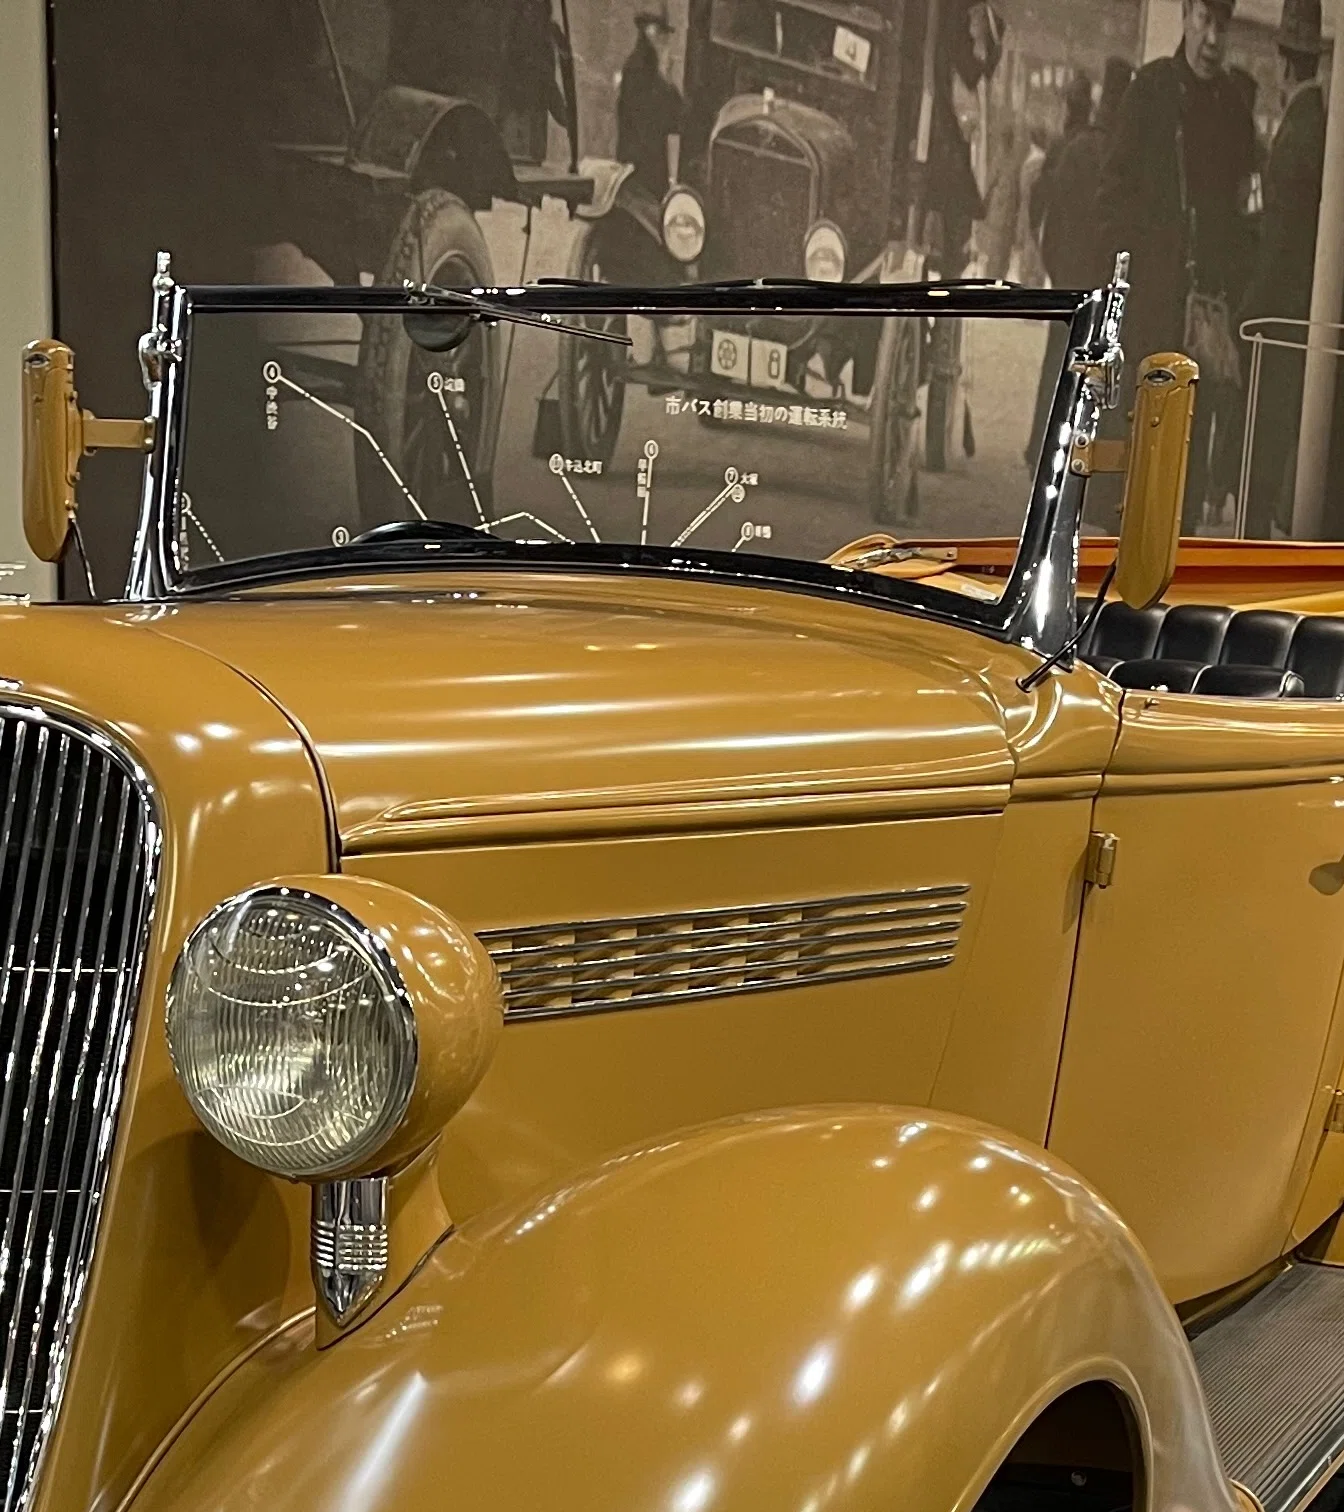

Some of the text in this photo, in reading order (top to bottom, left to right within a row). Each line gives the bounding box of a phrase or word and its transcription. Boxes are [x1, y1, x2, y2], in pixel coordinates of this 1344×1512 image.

[664, 395, 849, 430] 市バス創業当初の運転系統
